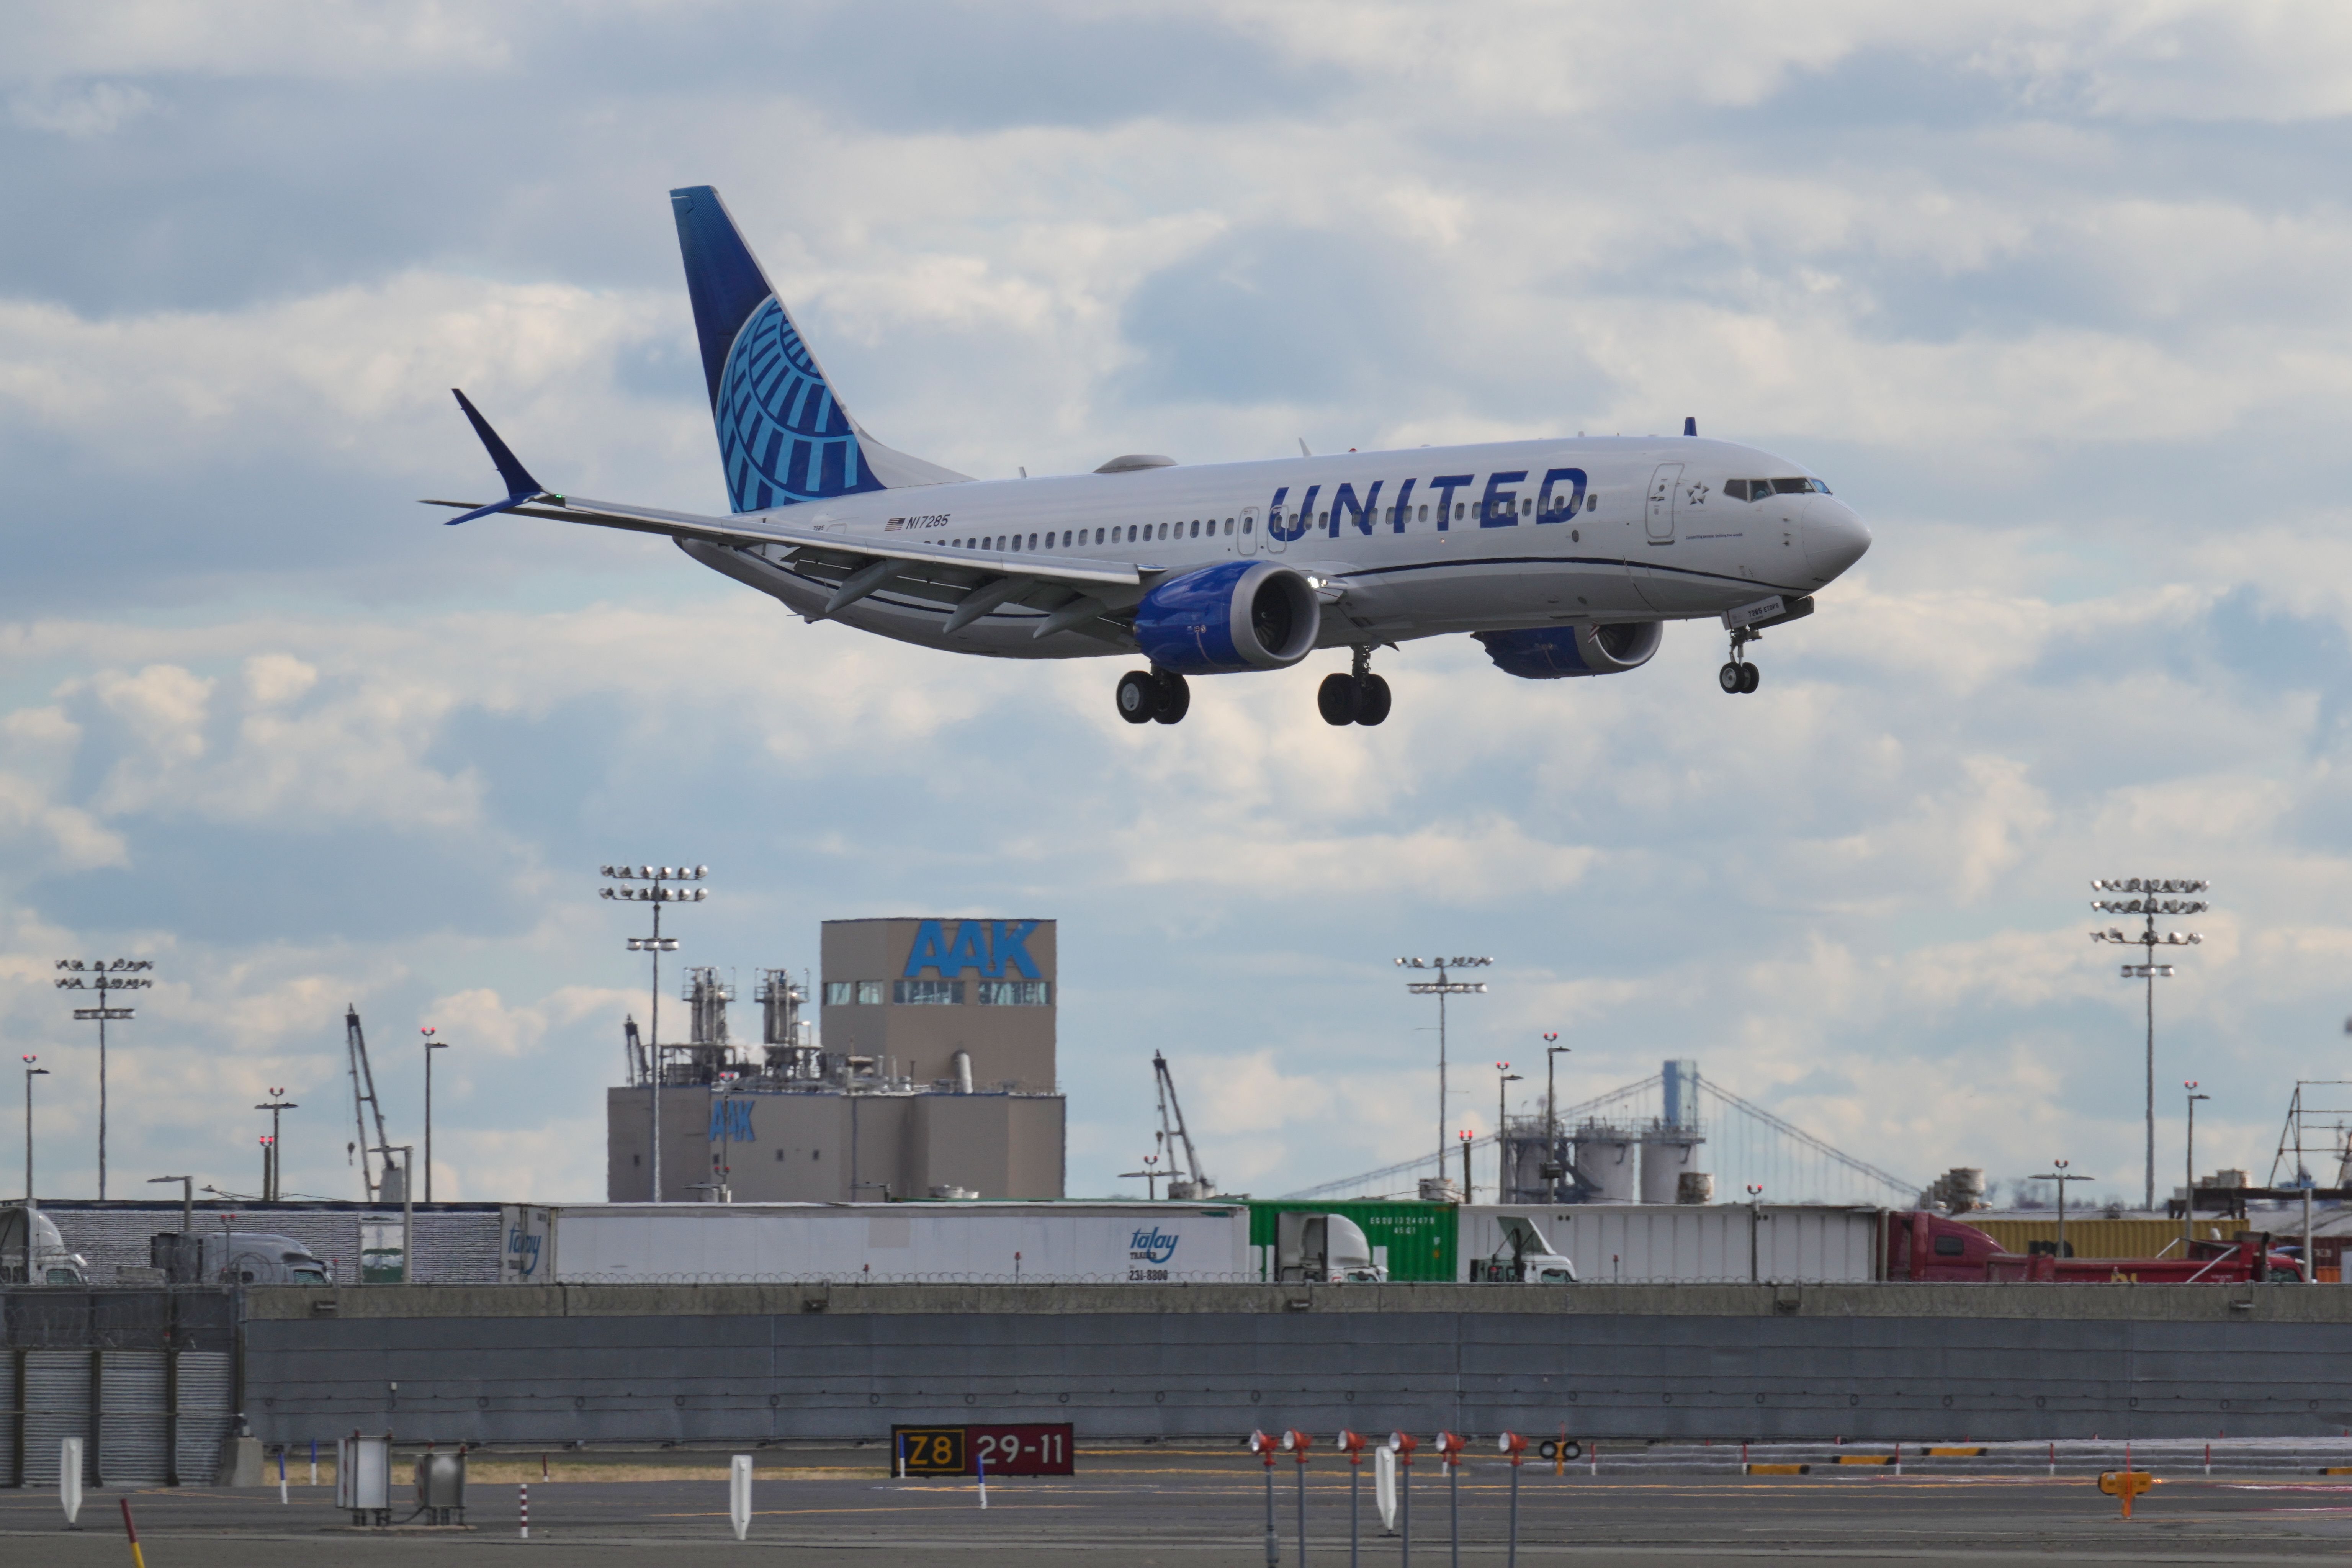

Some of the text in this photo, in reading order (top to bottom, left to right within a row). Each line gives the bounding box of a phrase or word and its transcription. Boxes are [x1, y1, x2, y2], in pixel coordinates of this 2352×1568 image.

[906, 514, 950, 530] N17285
[1268, 468, 1587, 542] UNITED
[1748, 607, 1762, 618] 7285
[1763, 603, 1779, 612] ETOPS
[904, 920, 1043, 978] AAK
[709, 1100, 756, 1141] AAK
[509, 1221, 542, 1275] taay
[1130, 1226, 1179, 1264] talay
[909, 1434, 1062, 1465] Z8 29-11
